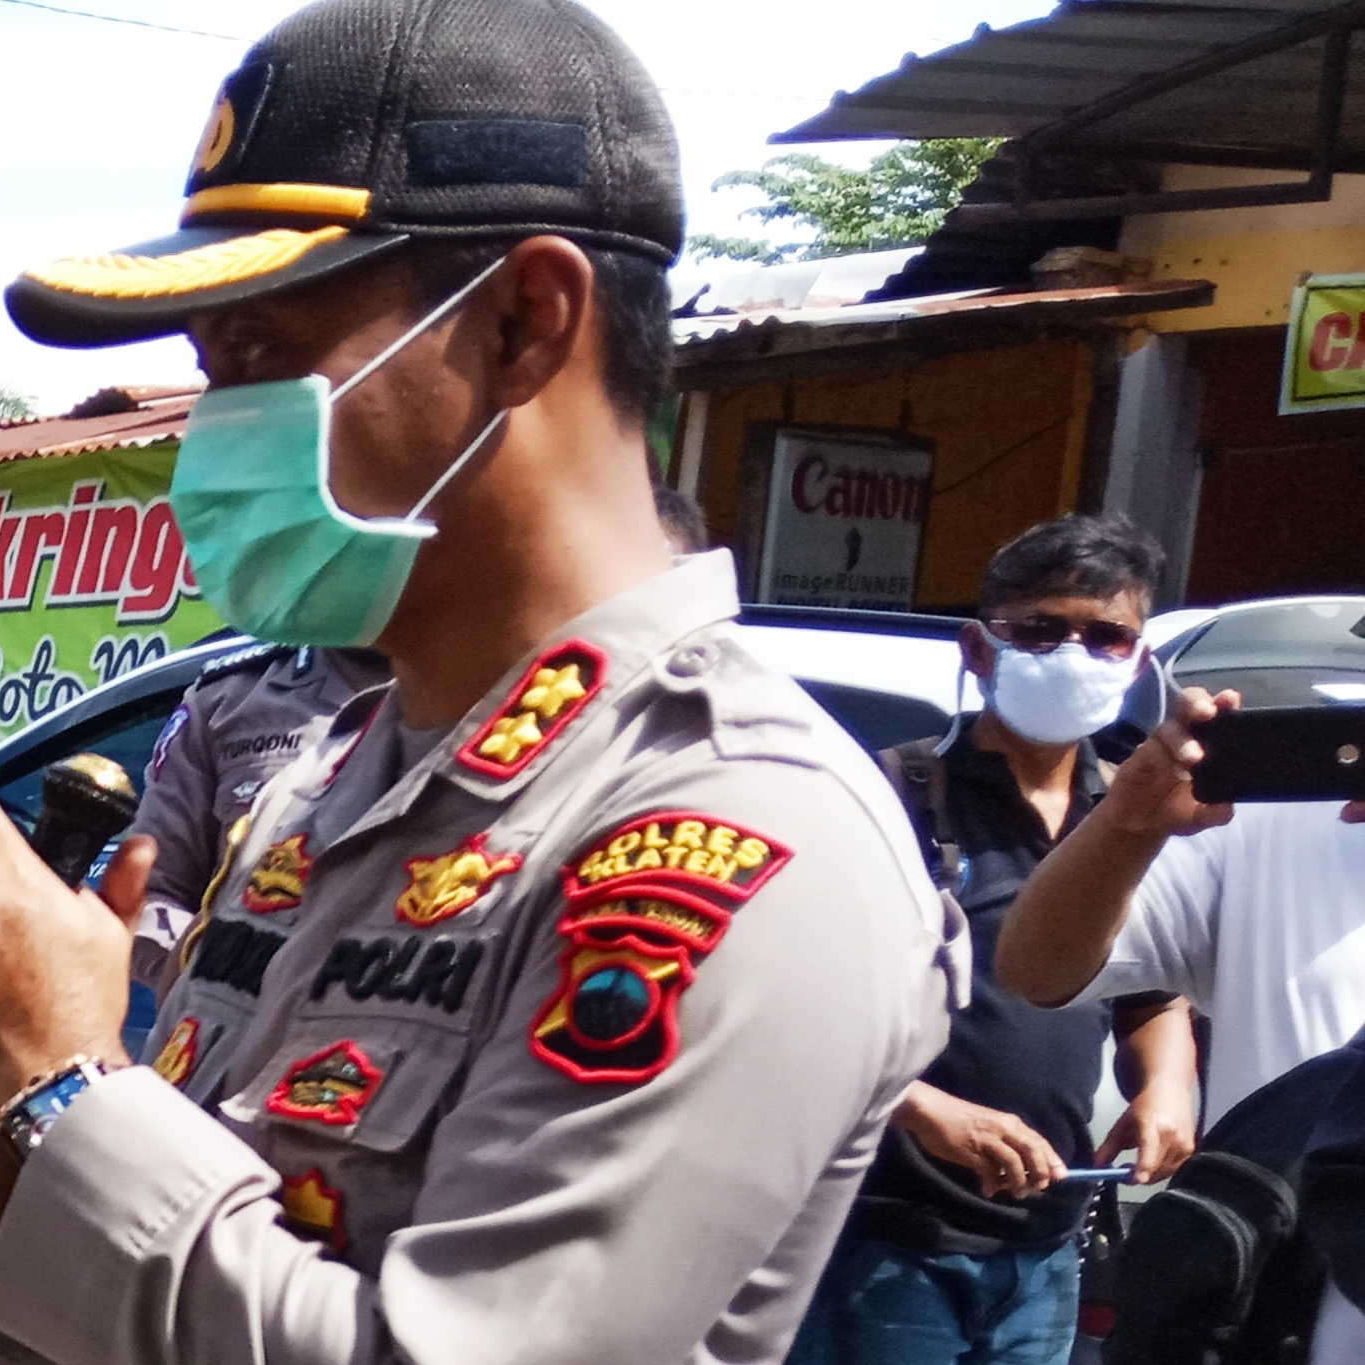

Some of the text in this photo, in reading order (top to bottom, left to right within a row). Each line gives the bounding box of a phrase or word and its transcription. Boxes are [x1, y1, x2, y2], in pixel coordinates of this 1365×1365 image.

[791, 453, 930, 522] Canon
[775, 573, 909, 594] imageRUNNER
[311, 935, 484, 1013] POLRI
